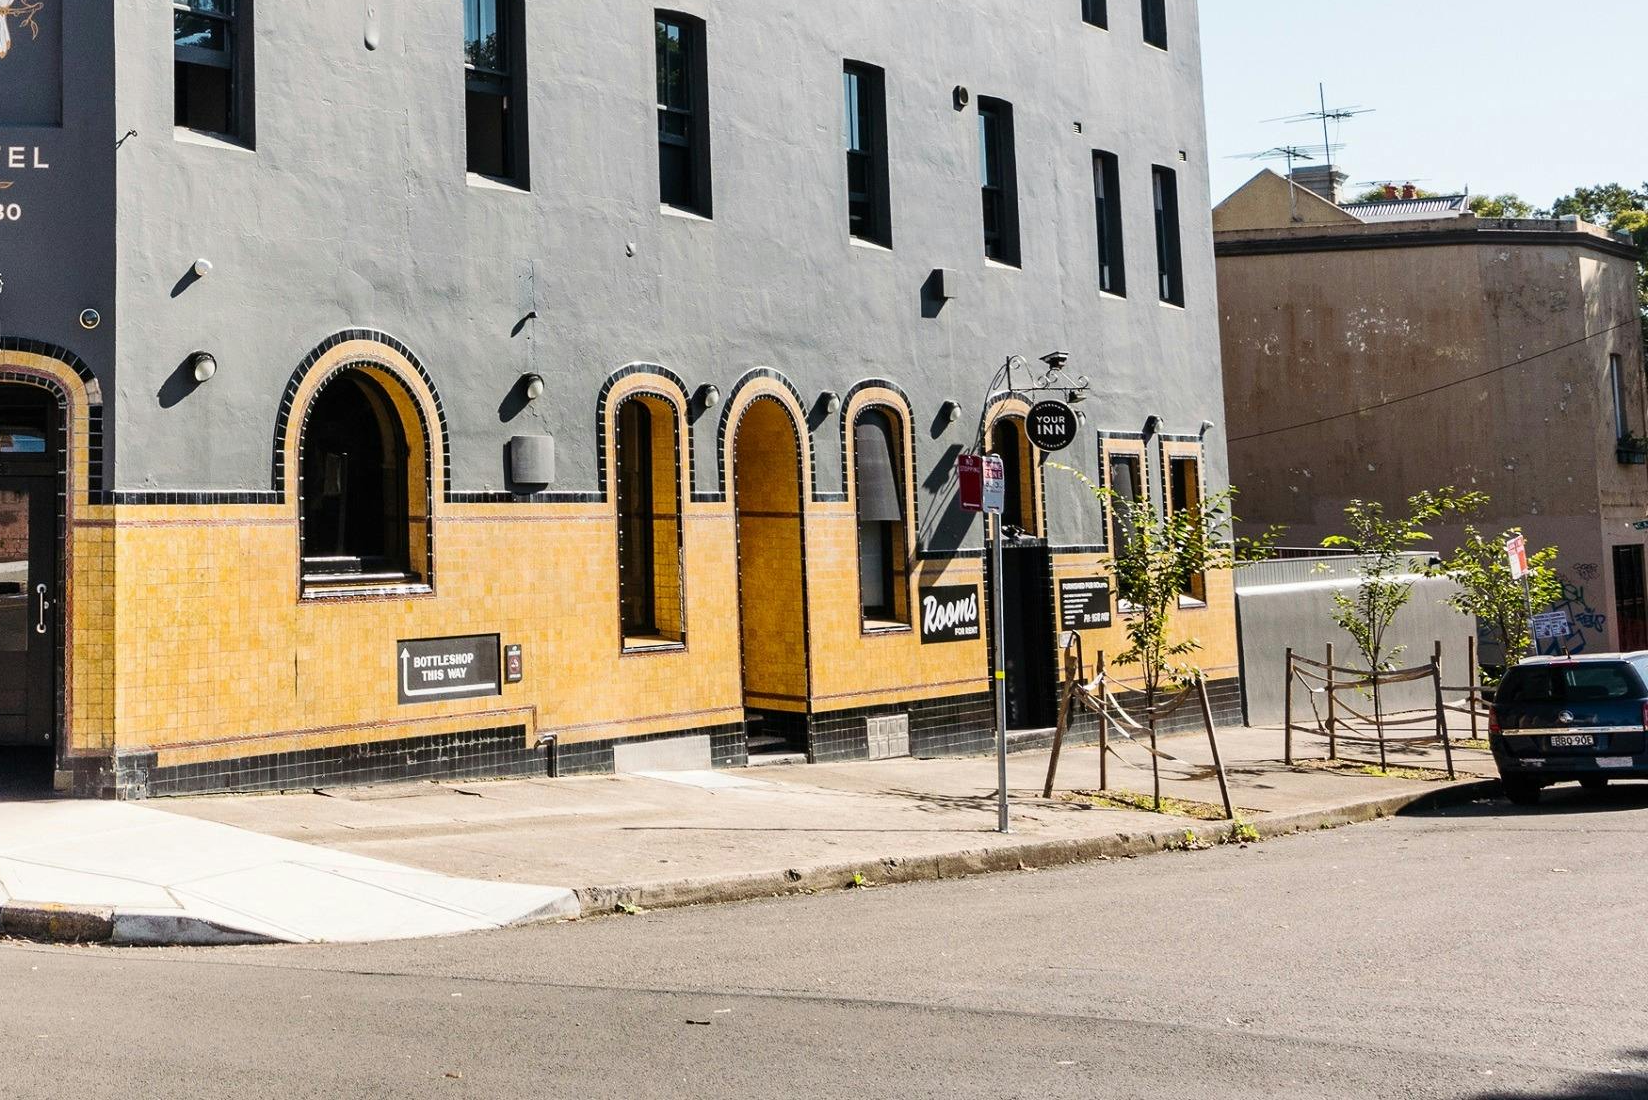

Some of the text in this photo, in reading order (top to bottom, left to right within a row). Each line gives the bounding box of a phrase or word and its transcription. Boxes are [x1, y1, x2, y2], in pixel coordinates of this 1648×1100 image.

[1037, 424, 1066, 435] INN
[923, 593, 977, 635] Rooms
[954, 626, 978, 635] FOR RENT
[413, 653, 474, 668] BOTTLESHOP
[421, 667, 468, 681] THIS WAY
